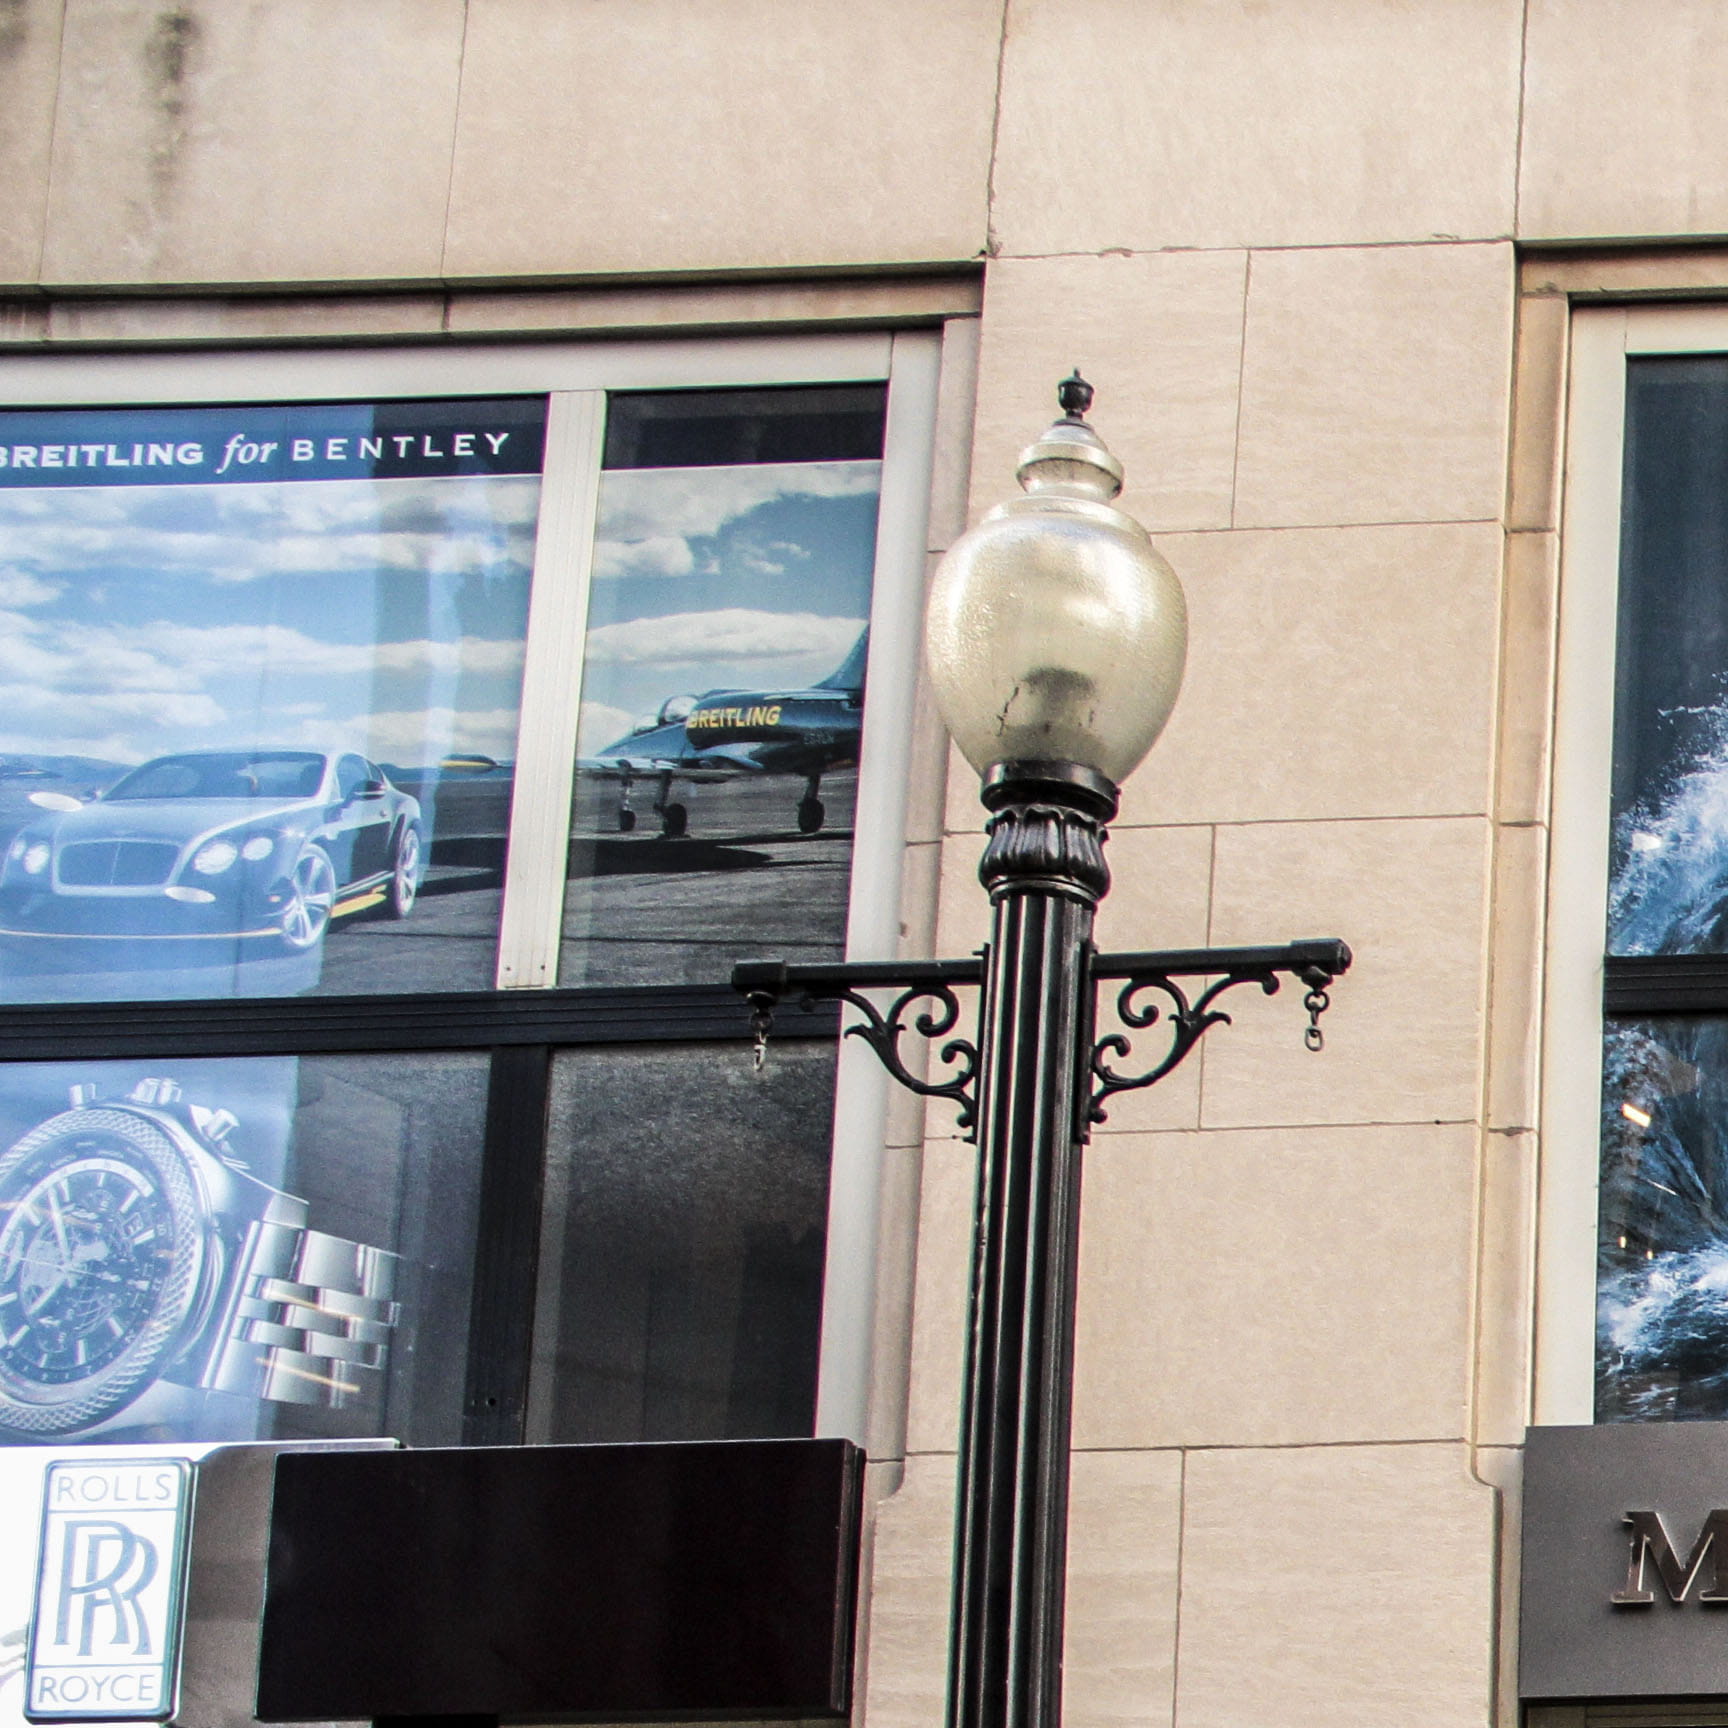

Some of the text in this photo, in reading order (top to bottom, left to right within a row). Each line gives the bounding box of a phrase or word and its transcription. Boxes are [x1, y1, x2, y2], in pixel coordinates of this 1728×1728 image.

[214, 433, 278, 474] for
[292, 432, 510, 462] BENTLEY
[687, 705, 783, 729] BREITLING
[57, 1472, 173, 1503] ROLLS
[38, 1673, 156, 1704] ROYCE
